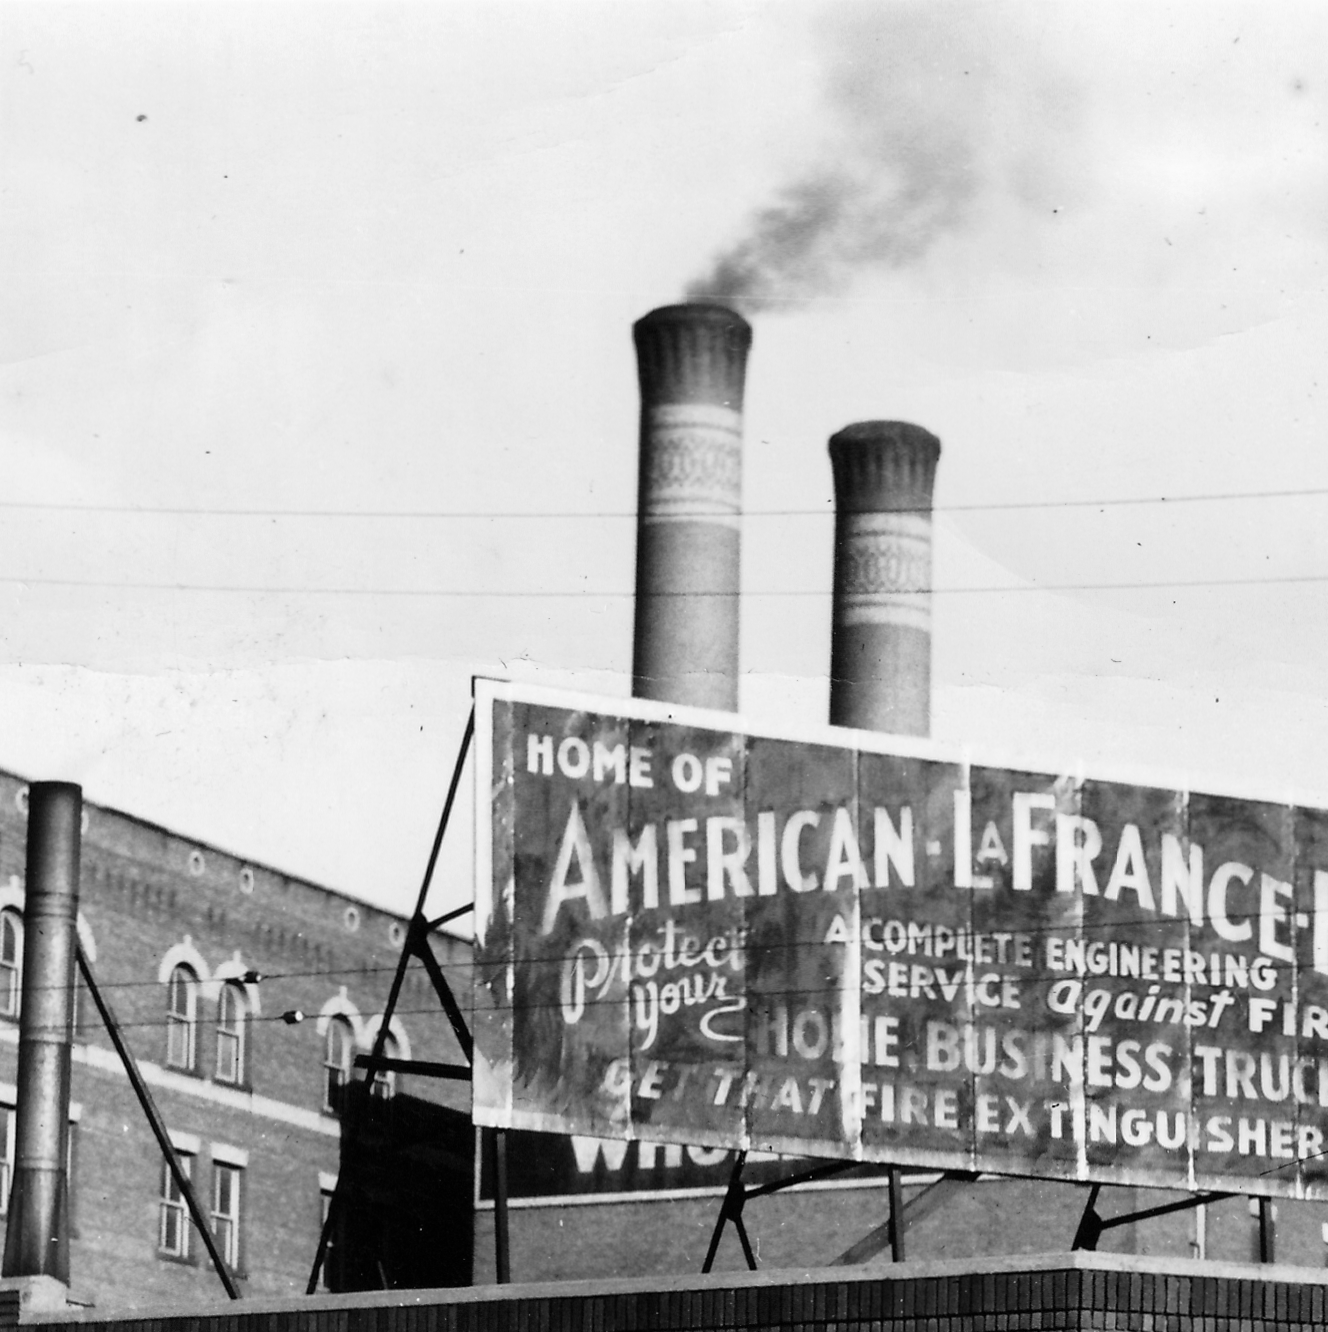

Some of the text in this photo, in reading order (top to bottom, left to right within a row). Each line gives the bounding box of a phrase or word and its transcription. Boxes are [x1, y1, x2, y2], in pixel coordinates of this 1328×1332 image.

[527, 733, 733, 795] HOME OF
[560, 920, 748, 1024] Protect
[824, 913, 1278, 990] A COMPLETE ENGINEERING
[634, 973, 728, 1050] your
[862, 959, 1022, 1009] SERVICE
[1048, 980, 1235, 1032] against
[926, 1019, 1173, 1092] BUSINESS
[712, 1065, 835, 1115] THAT
[853, 1082, 958, 1130] FIRE
